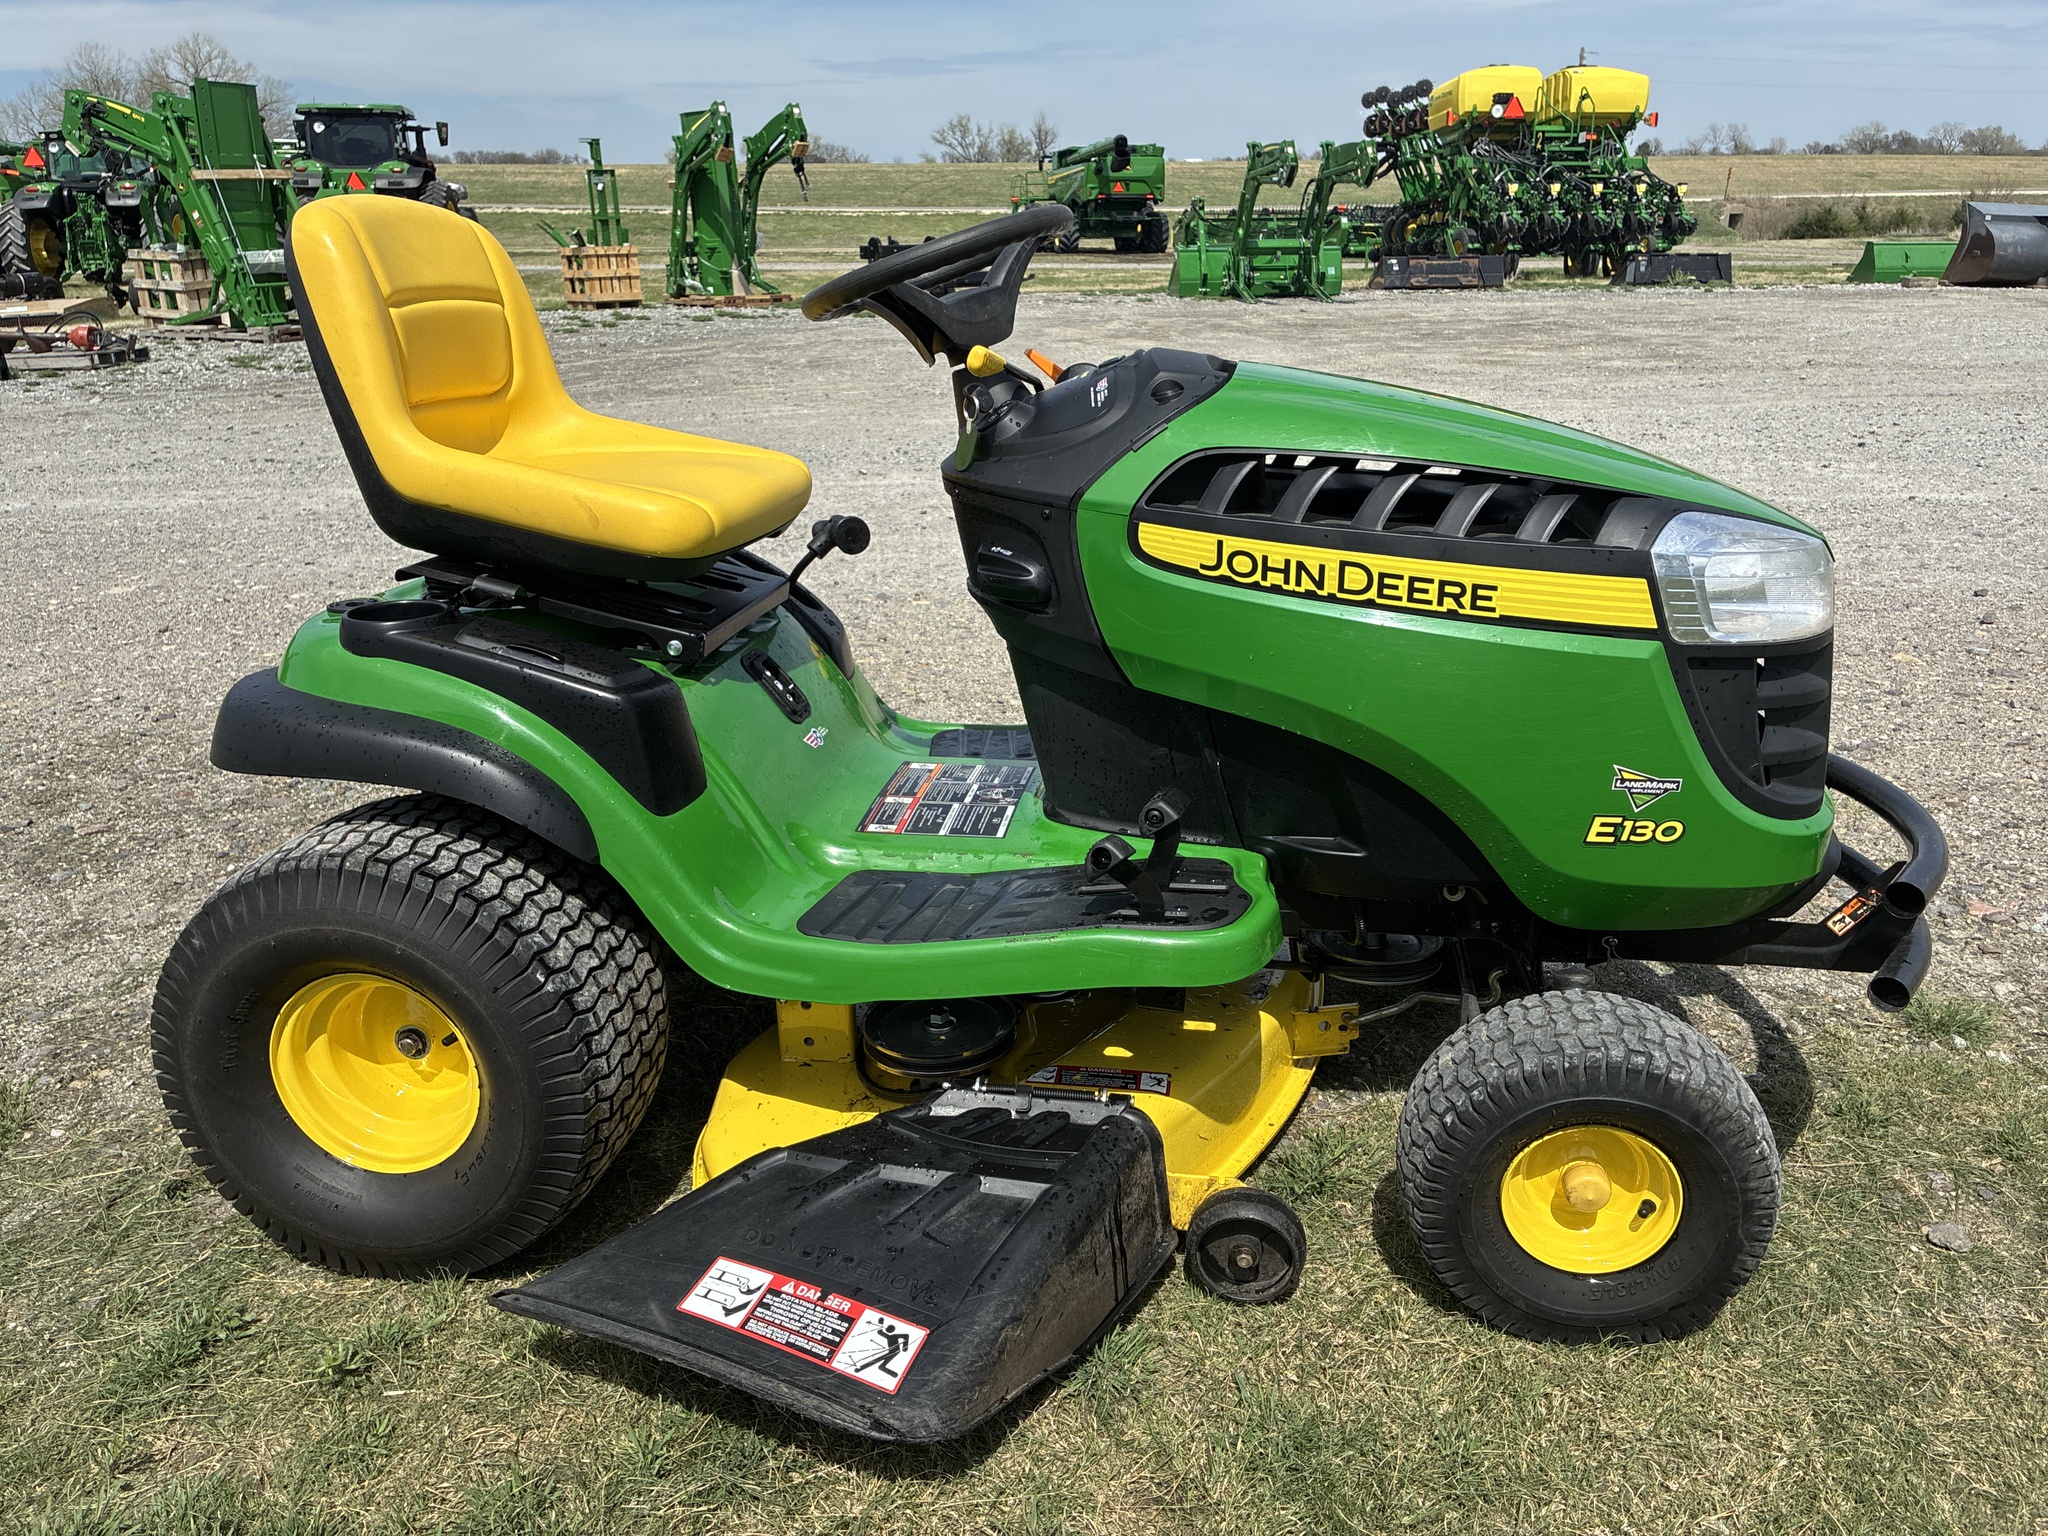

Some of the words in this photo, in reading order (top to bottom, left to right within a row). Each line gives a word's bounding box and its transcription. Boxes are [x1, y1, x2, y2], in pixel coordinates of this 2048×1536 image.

[1199, 540, 1326, 593] JOHN
[1336, 560, 1499, 613] DEERE
[1585, 816, 1685, 844] E130
[293, 1163, 321, 1186] TUBELESS
[741, 1228, 779, 1248] DO
[781, 1238, 836, 1264] NOT
[835, 1254, 947, 1305] REMOVE
[1589, 1255, 1682, 1302] CARLISLE
[768, 1305, 800, 1320] THROWN
[798, 1317, 833, 1333] OBJECTS
[779, 1292, 815, 1309] ROTATING
[814, 1305, 839, 1318] BLADE
